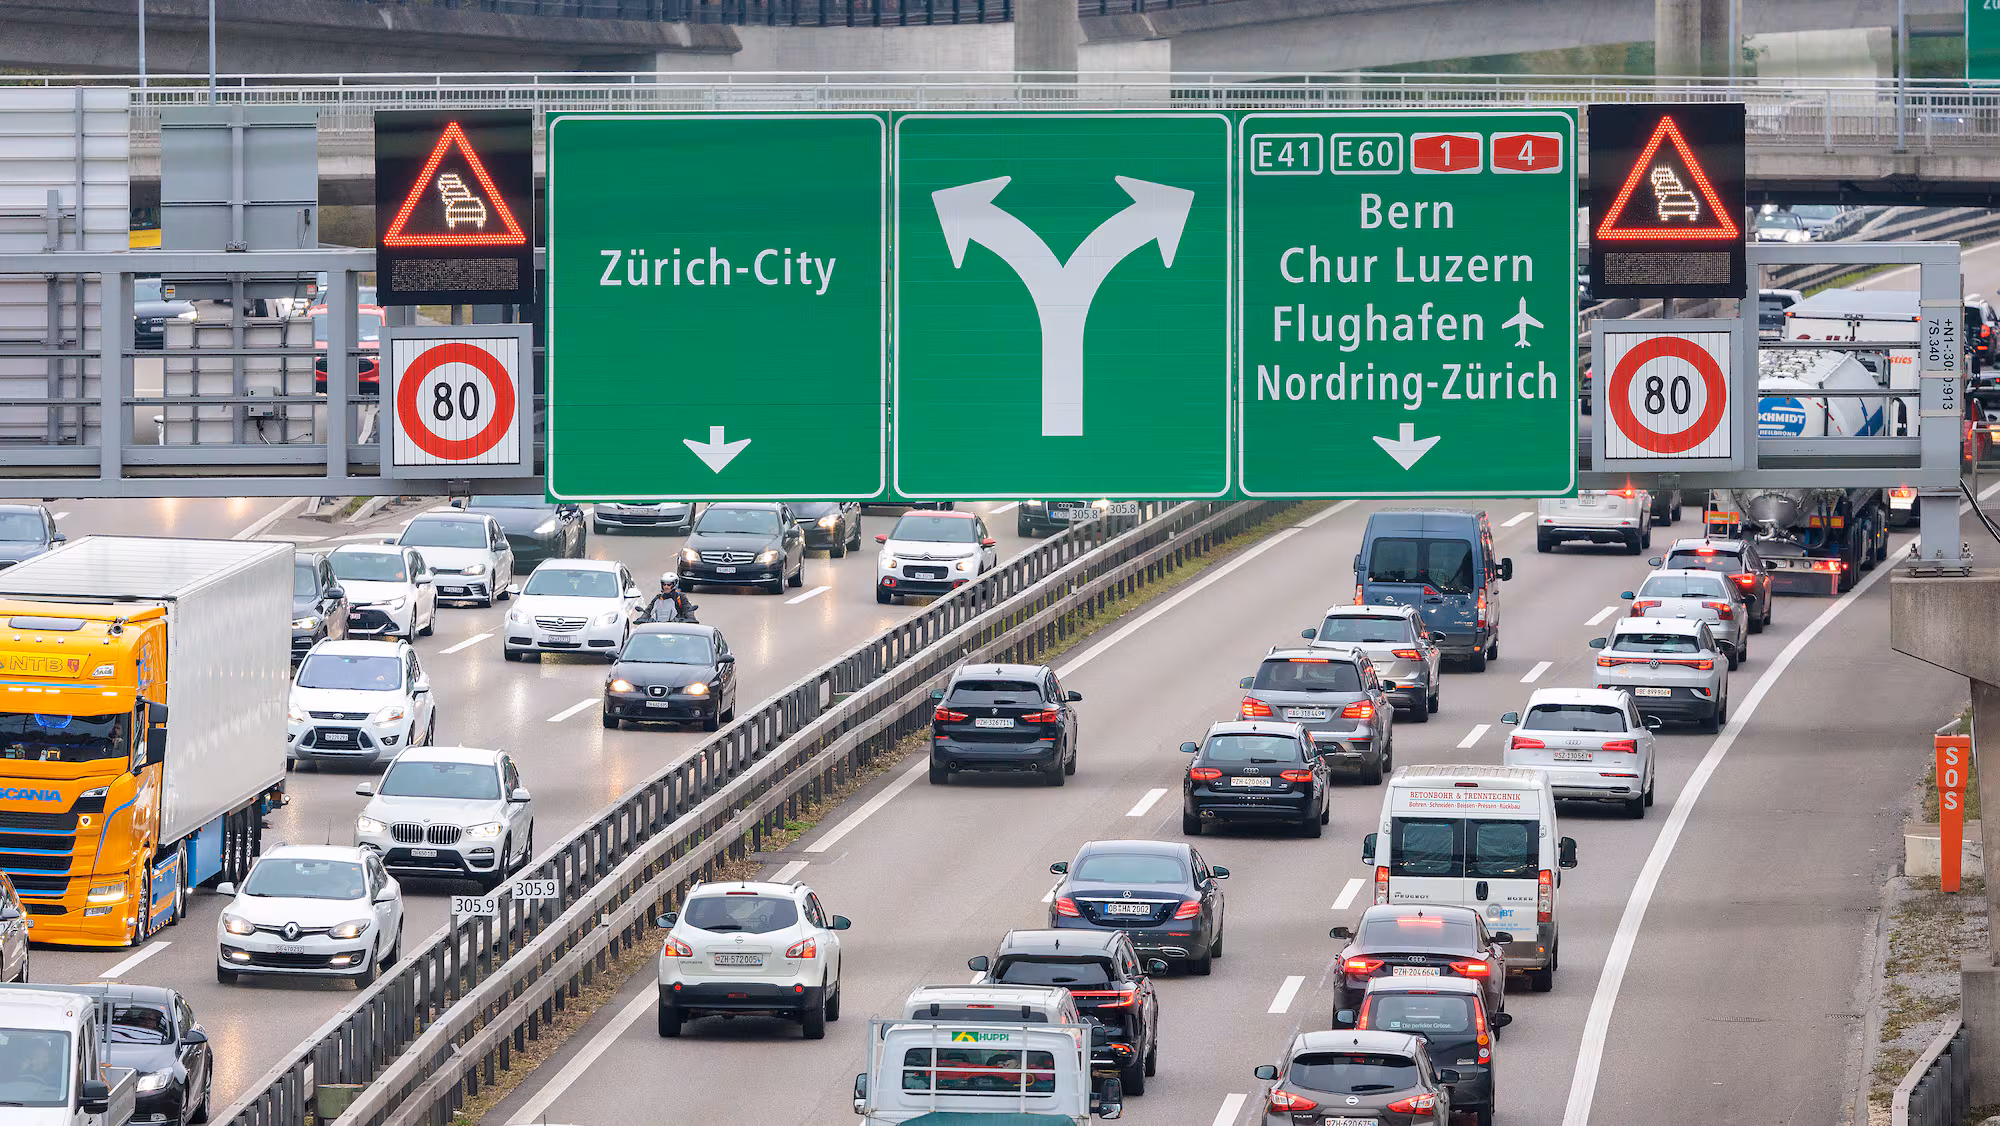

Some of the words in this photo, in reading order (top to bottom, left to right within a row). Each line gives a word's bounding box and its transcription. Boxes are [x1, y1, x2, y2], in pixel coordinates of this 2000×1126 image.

[1258, 141, 1309, 167] E41
[1338, 140, 1393, 167] E60
[1440, 140, 1451, 167] 1
[1517, 140, 1535, 166] 4
[1360, 193, 1453, 229] Bern
[600, 246, 836, 296] Zürich-City
[1280, 245, 1378, 284] Chur
[1396, 246, 1533, 283] Luzern
[1274, 301, 1484, 353] Flughafen
[1942, 318, 1955, 410] +N1-:300:913
[433, 382, 480, 421] 80
[1257, 360, 1557, 411] Nordring-Zürich
[1644, 375, 1691, 415] 80
[1071, 509, 1098, 519] 305.8
[1110, 503, 1136, 514] 305.8
[9, 655, 63, 672] NTB
[1409, 791, 1453, 799] BETONBOHR
[1464, 792, 1521, 800] TRENNTECHNIK
[1944, 746, 1959, 811] SOS
[455, 898, 494, 913] 305.9
[516, 881, 555, 896] 305.9
[1132, 905, 1149, 913] 2002
